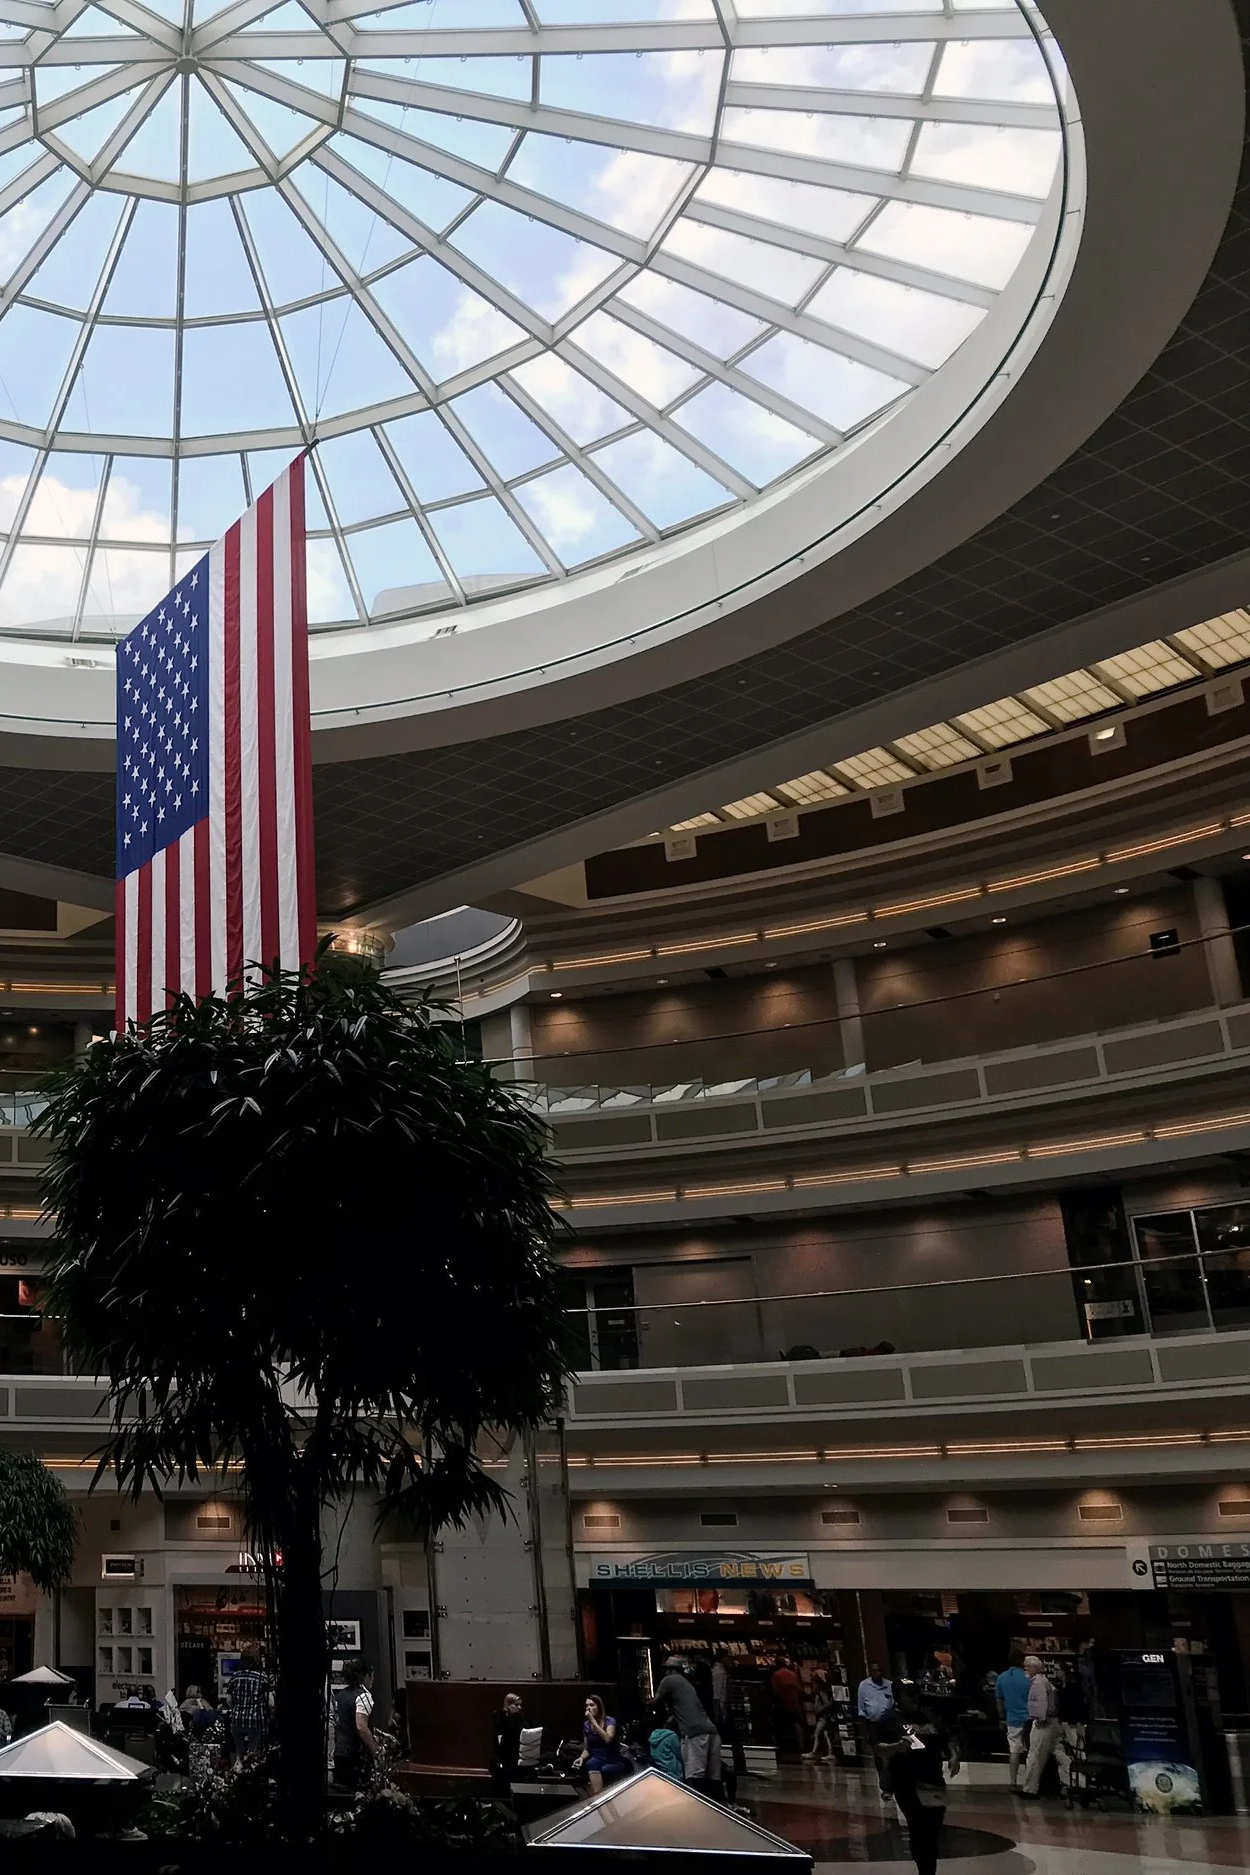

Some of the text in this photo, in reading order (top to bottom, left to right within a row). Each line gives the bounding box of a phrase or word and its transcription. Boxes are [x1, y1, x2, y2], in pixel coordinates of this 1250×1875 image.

[0, 1253, 28, 1266] USO
[597, 1562, 805, 1577] SHELLIS NEWS
[1167, 1561, 1188, 1569] North
[1189, 1561, 1221, 1569] Domestic
[1197, 1574, 1250, 1583] Transportation
[1141, 1654, 1165, 1664] GEN
